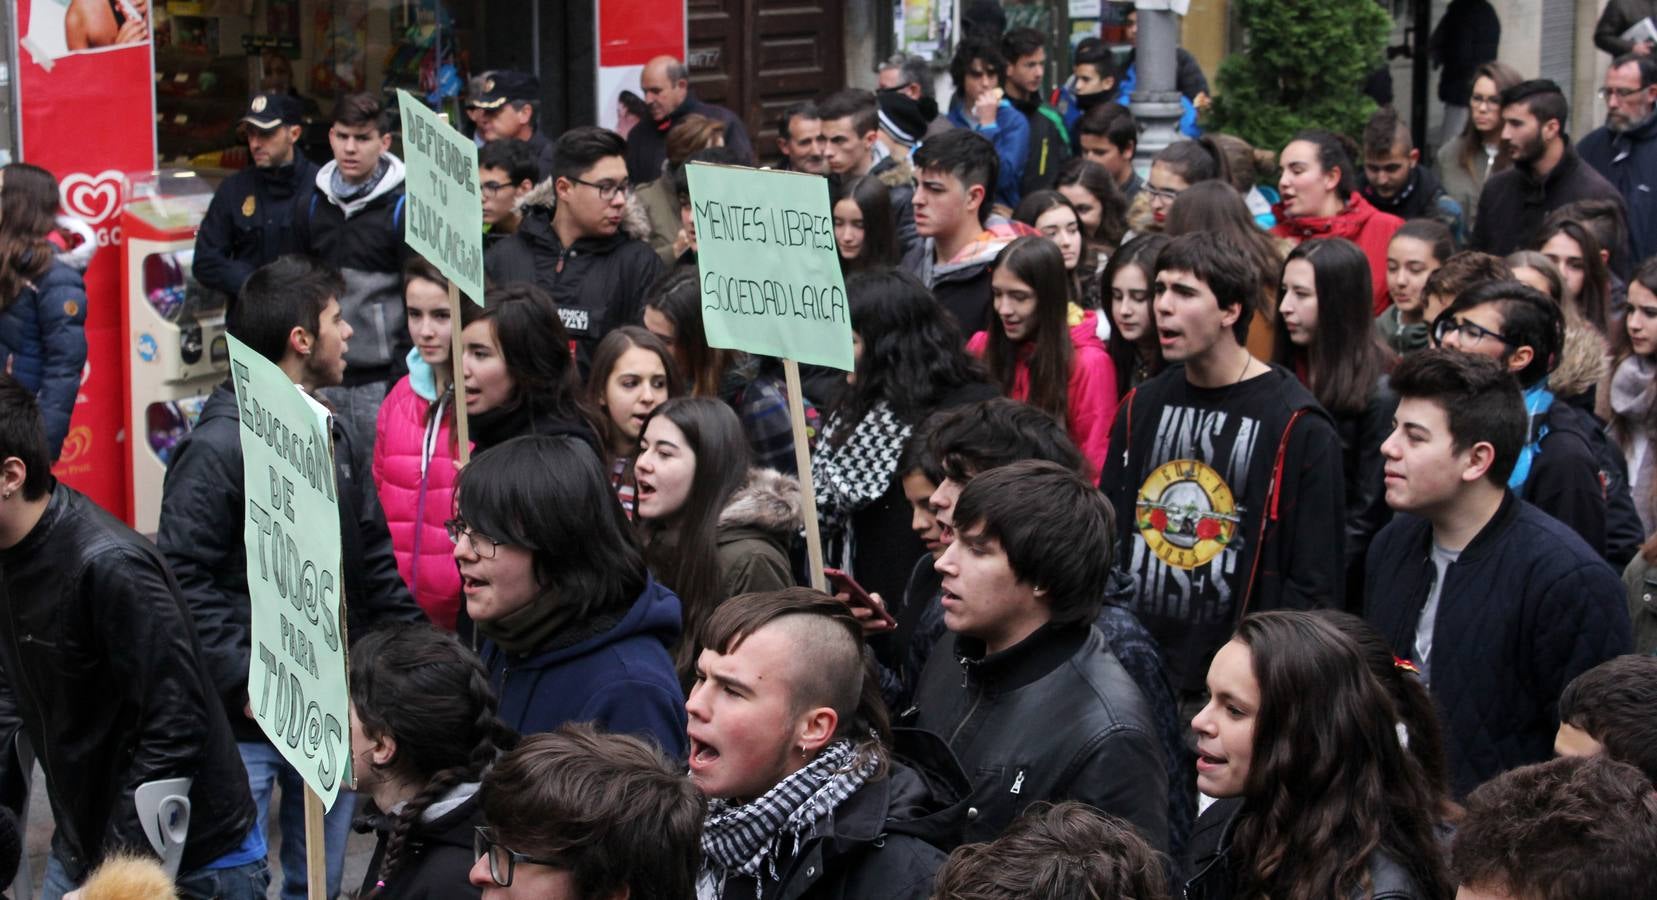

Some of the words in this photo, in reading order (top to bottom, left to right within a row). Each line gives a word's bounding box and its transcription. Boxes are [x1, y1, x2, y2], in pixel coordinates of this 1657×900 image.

[406, 108, 475, 195] DEFIENDE
[430, 171, 448, 206] TU
[694, 200, 767, 243] MENTES
[771, 207, 834, 251] LIBRES
[704, 271, 787, 316] SOCIEDAD
[789, 284, 845, 324] LAICA
[269, 465, 295, 523] DE
[250, 498, 338, 652] TOD@S
[280, 613, 319, 680] PARA
[259, 641, 342, 791] TOD@S
